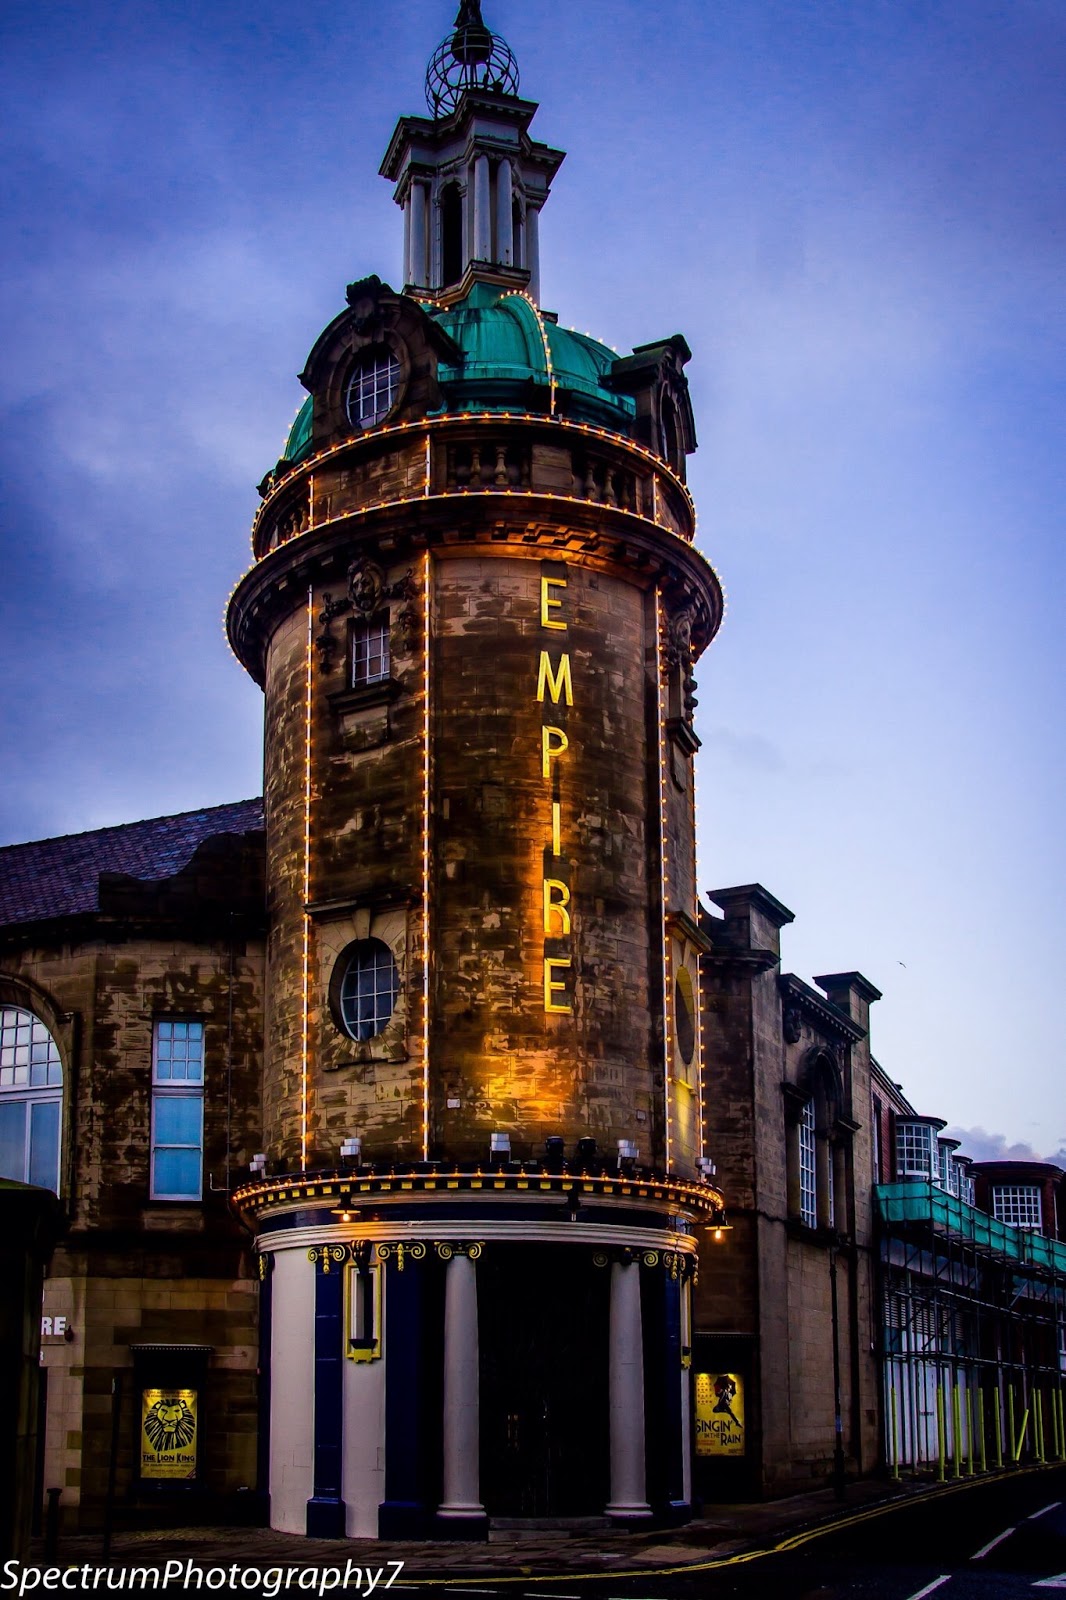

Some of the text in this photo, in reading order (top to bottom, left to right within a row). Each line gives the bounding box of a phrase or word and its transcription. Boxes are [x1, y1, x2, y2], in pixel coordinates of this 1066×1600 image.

[537, 576, 574, 1014] EMPIRE
[696, 1419, 733, 1433] SINGIN'
[720, 1432, 741, 1446] RAIN
[143, 1454, 156, 1463] THE
